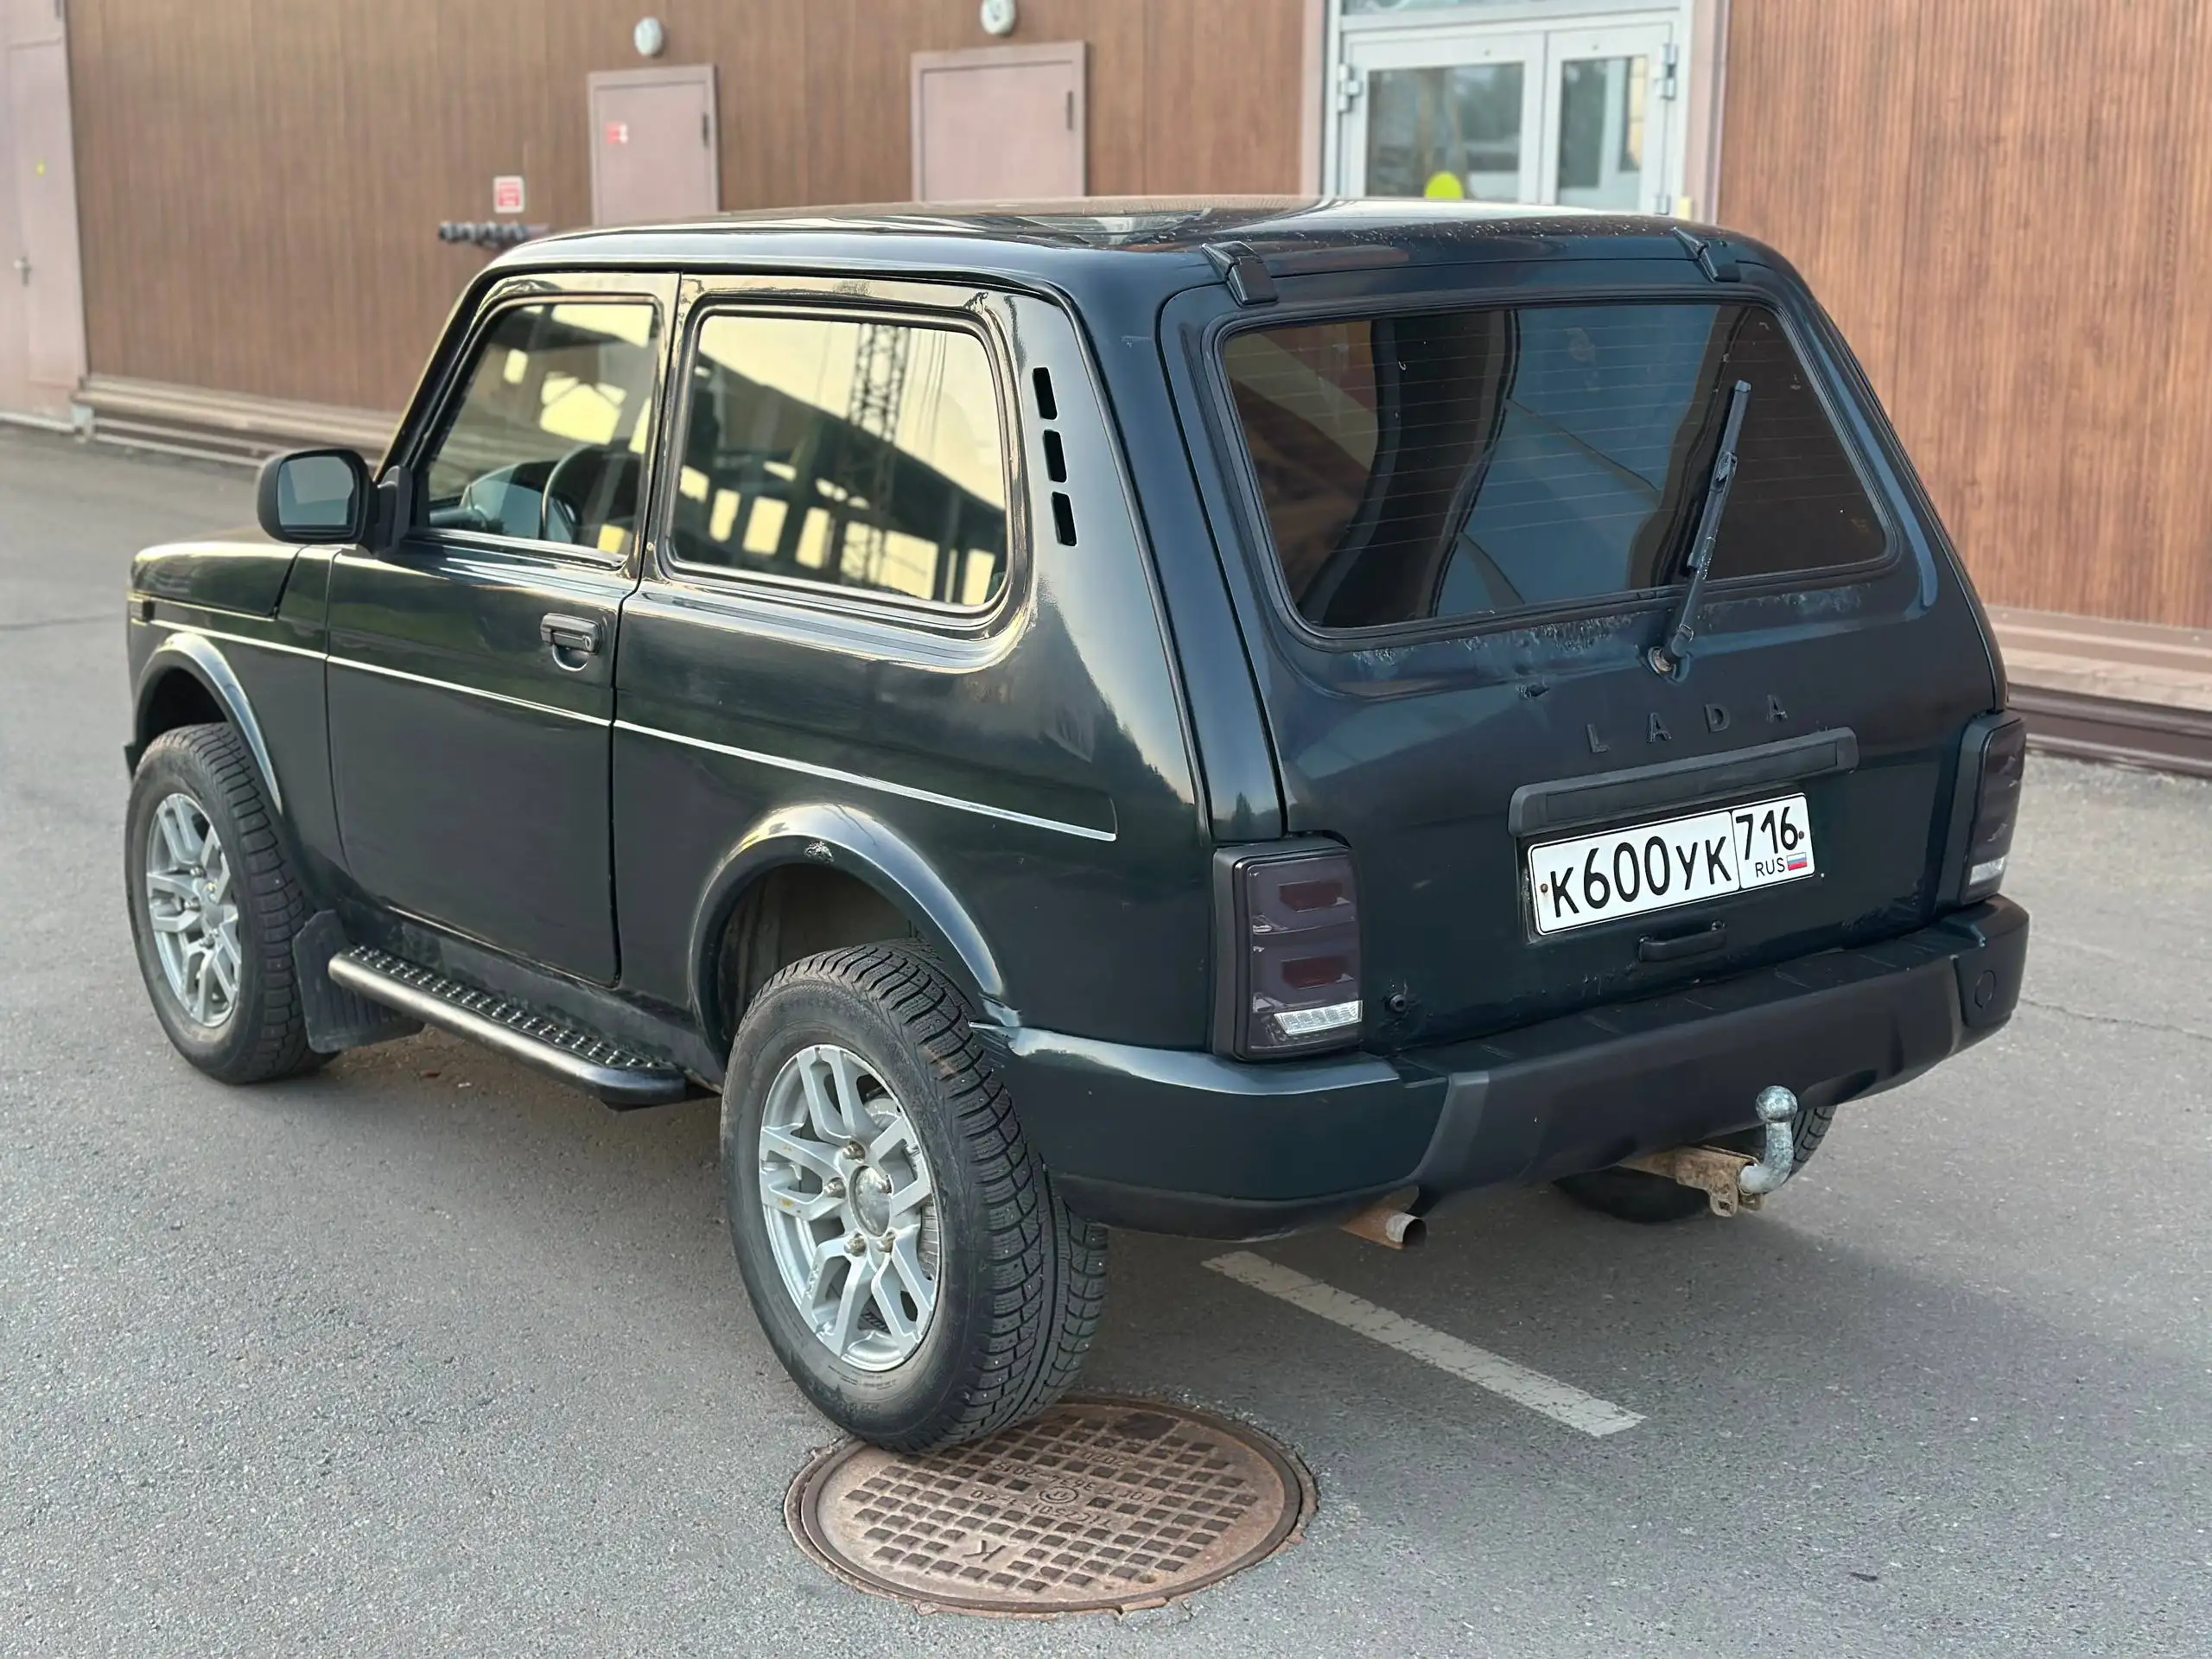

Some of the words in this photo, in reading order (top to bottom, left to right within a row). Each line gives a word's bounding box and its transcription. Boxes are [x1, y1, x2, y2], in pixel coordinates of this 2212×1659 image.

[1586, 694, 1789, 753] LADA
[1550, 836, 1732, 918] К600УК
[1735, 806, 1799, 861] 716
[1755, 857, 1786, 878] RUS
